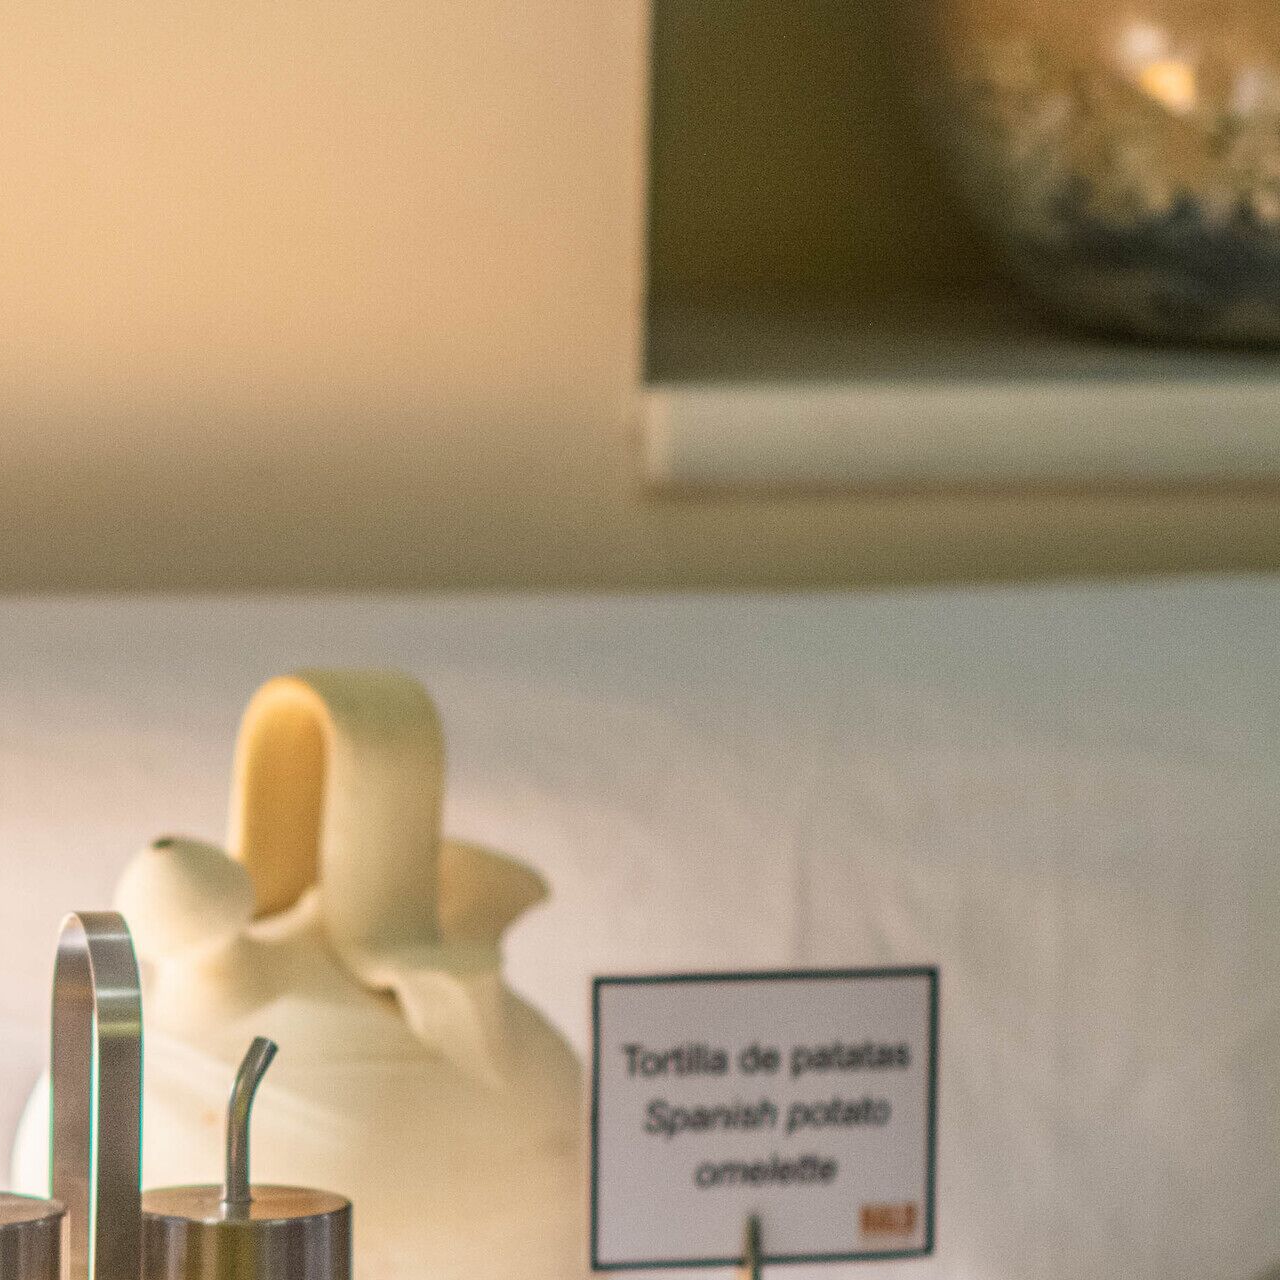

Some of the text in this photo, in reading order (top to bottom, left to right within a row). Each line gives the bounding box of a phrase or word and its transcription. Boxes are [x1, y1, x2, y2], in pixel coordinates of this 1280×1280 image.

[622, 1042, 911, 1079] Tortilla de patatas
[645, 1098, 891, 1139] Spanish potato
[695, 1156, 837, 1188] omelette
